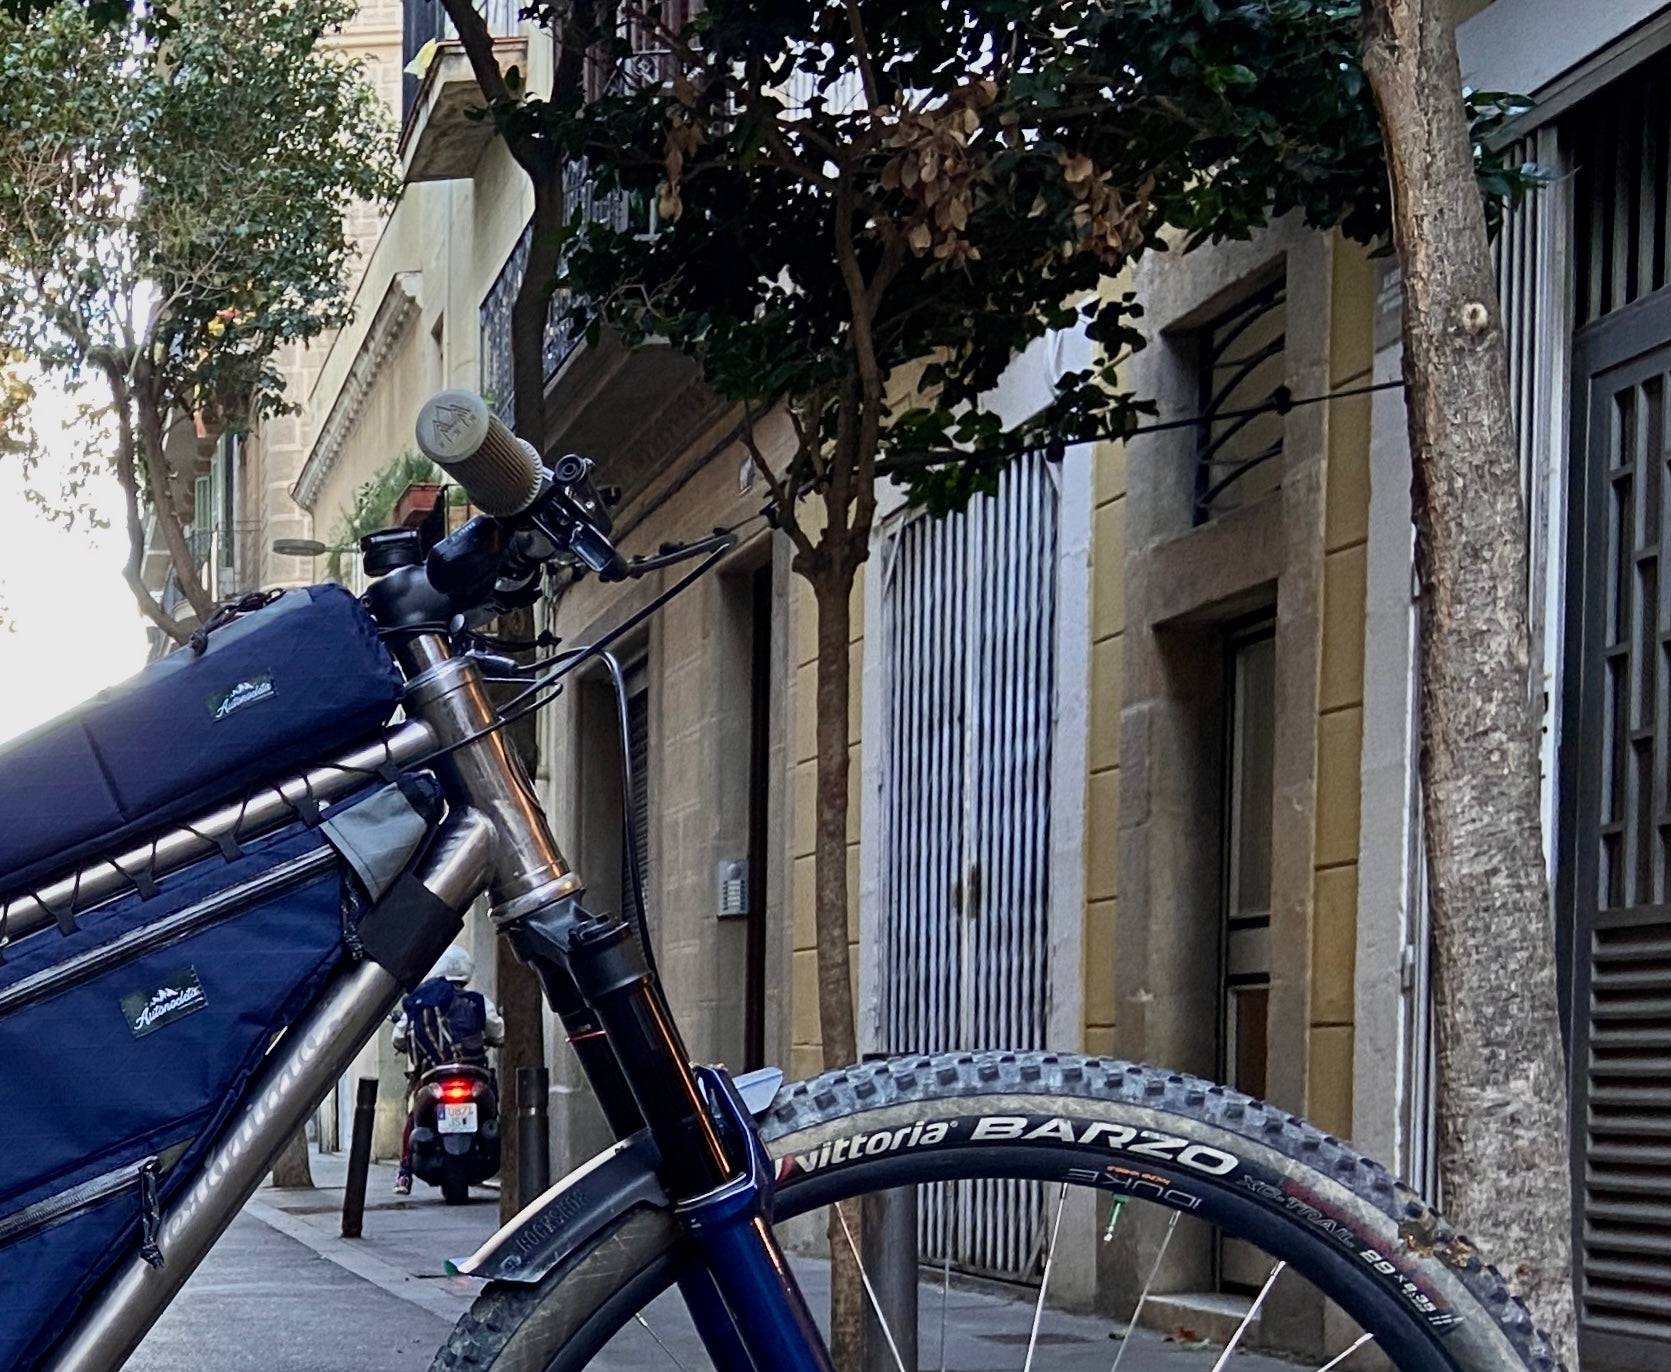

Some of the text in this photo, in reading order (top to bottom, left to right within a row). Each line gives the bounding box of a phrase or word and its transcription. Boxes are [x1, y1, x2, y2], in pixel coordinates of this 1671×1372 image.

[795, 1117, 1239, 1175] vittoria BARZO
[1360, 1249, 1396, 1275] 29
